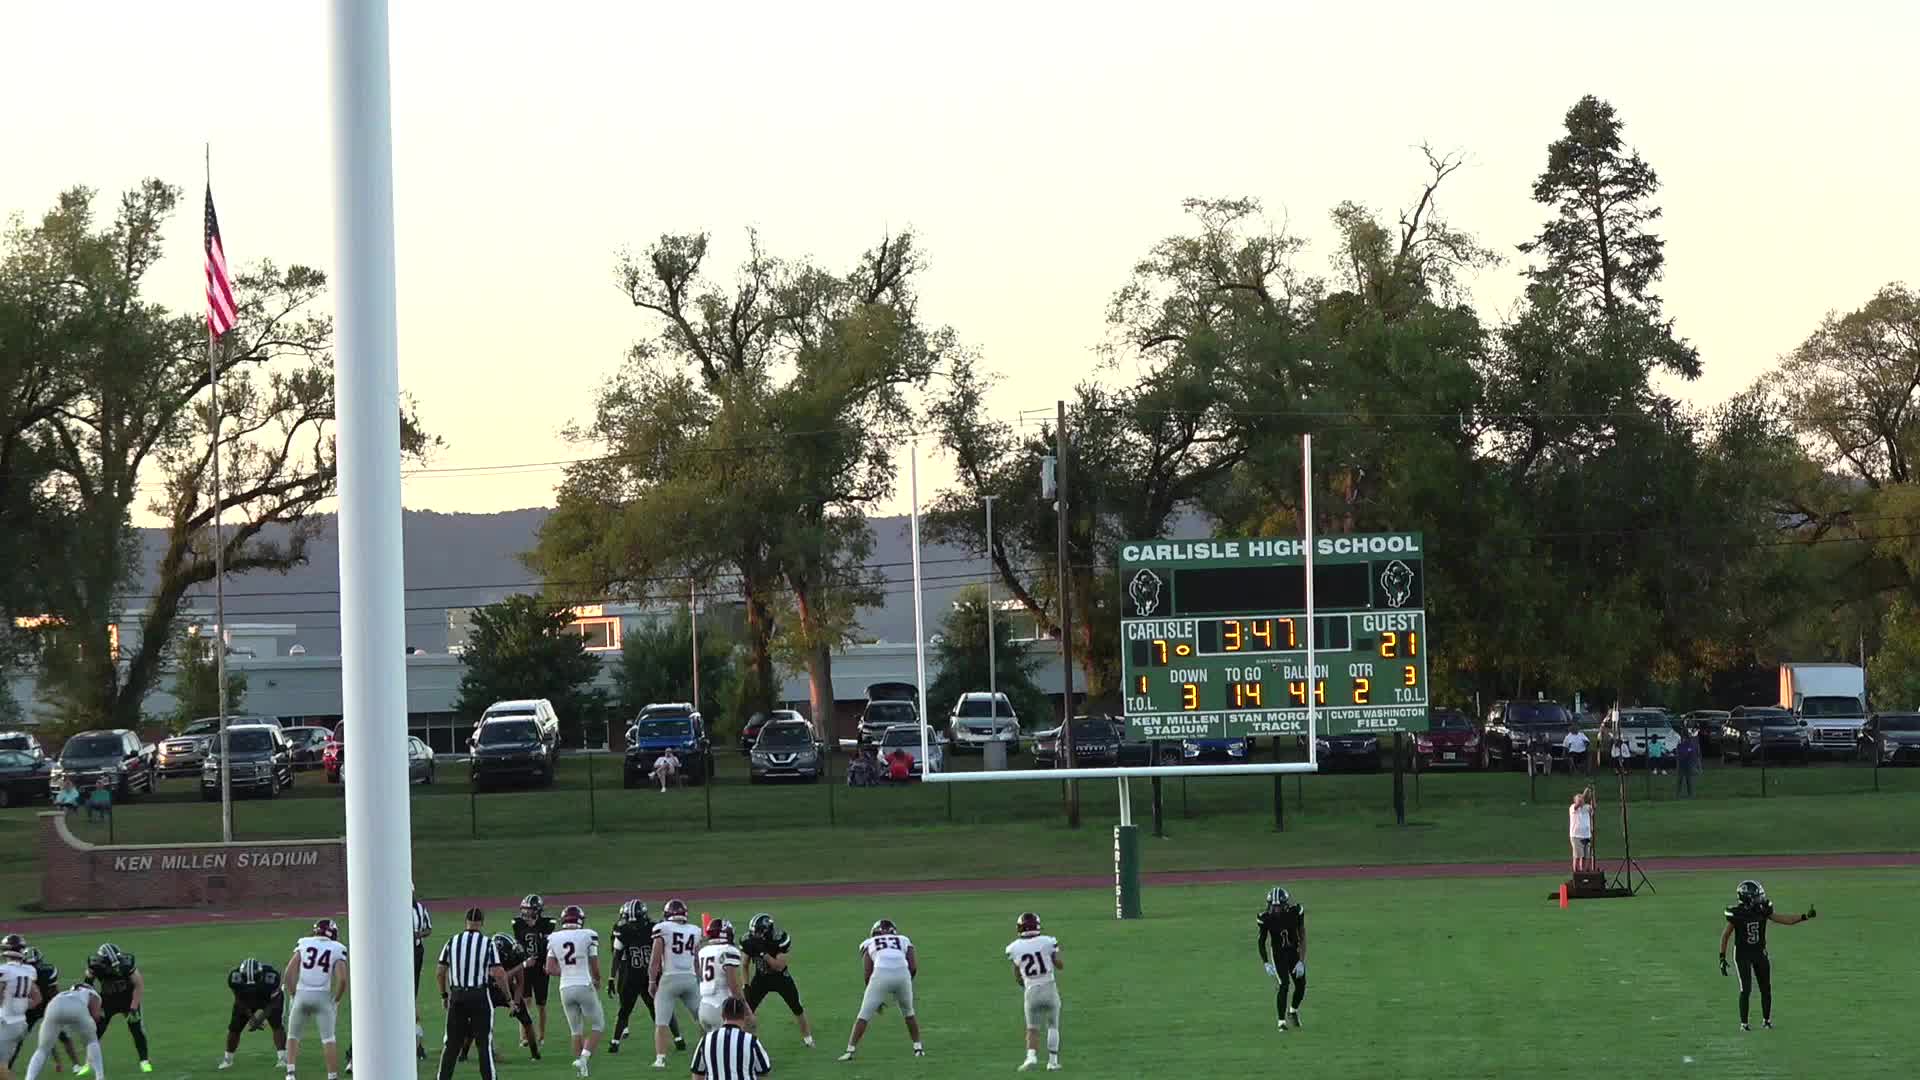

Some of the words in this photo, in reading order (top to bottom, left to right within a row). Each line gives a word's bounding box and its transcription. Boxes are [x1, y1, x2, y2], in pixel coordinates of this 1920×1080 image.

[1122, 541, 1239, 562] CARLISLE
[1249, 539, 1307, 558] HIGH
[1317, 535, 1419, 555] SCHOOL
[1128, 621, 1193, 640] CARLISLE
[1363, 614, 1418, 632] GUEST
[1224, 618, 1296, 651] 3:47
[1153, 640, 1168, 664] 7
[1380, 632, 1416, 658] 21
[1170, 669, 1208, 684] DOWN
[1225, 667, 1243, 681] TO
[1245, 666, 1262, 680] GO
[1313, 664, 1329, 678] ON
[1349, 663, 1374, 677] QTR
[1404, 666, 1416, 686] 3
[1139, 675, 1147, 694] 1
[1234, 682, 1261, 706] 14
[1354, 678, 1369, 704] 2
[1127, 697, 1158, 711] T.O.L.
[1183, 684, 1197, 710] 3
[1394, 688, 1425, 702] T.O.L.
[1132, 716, 1161, 726] KEN
[1167, 714, 1219, 725] MILLEN
[1229, 713, 1262, 723] STAN
[1331, 710, 1361, 719] CLYDE
[1363, 708, 1425, 718] WASHINGTON
[1357, 718, 1398, 728] FIELD
[1143, 725, 1209, 735] STADIUM
[1252, 721, 1301, 732] TRACK
[114, 856, 153, 871] KEN
[161, 854, 227, 870] MILLEN
[237, 851, 318, 868] STADIUM
[1113, 827, 1123, 919] CARLISLE
[1746, 922, 1760, 944] 5
[672, 932, 695, 955] 54
[874, 937, 902, 951] 53
[303, 946, 333, 973] 34
[563, 941, 577, 966] 2
[1021, 952, 1047, 977] 21
[14, 975, 29, 998] 11
